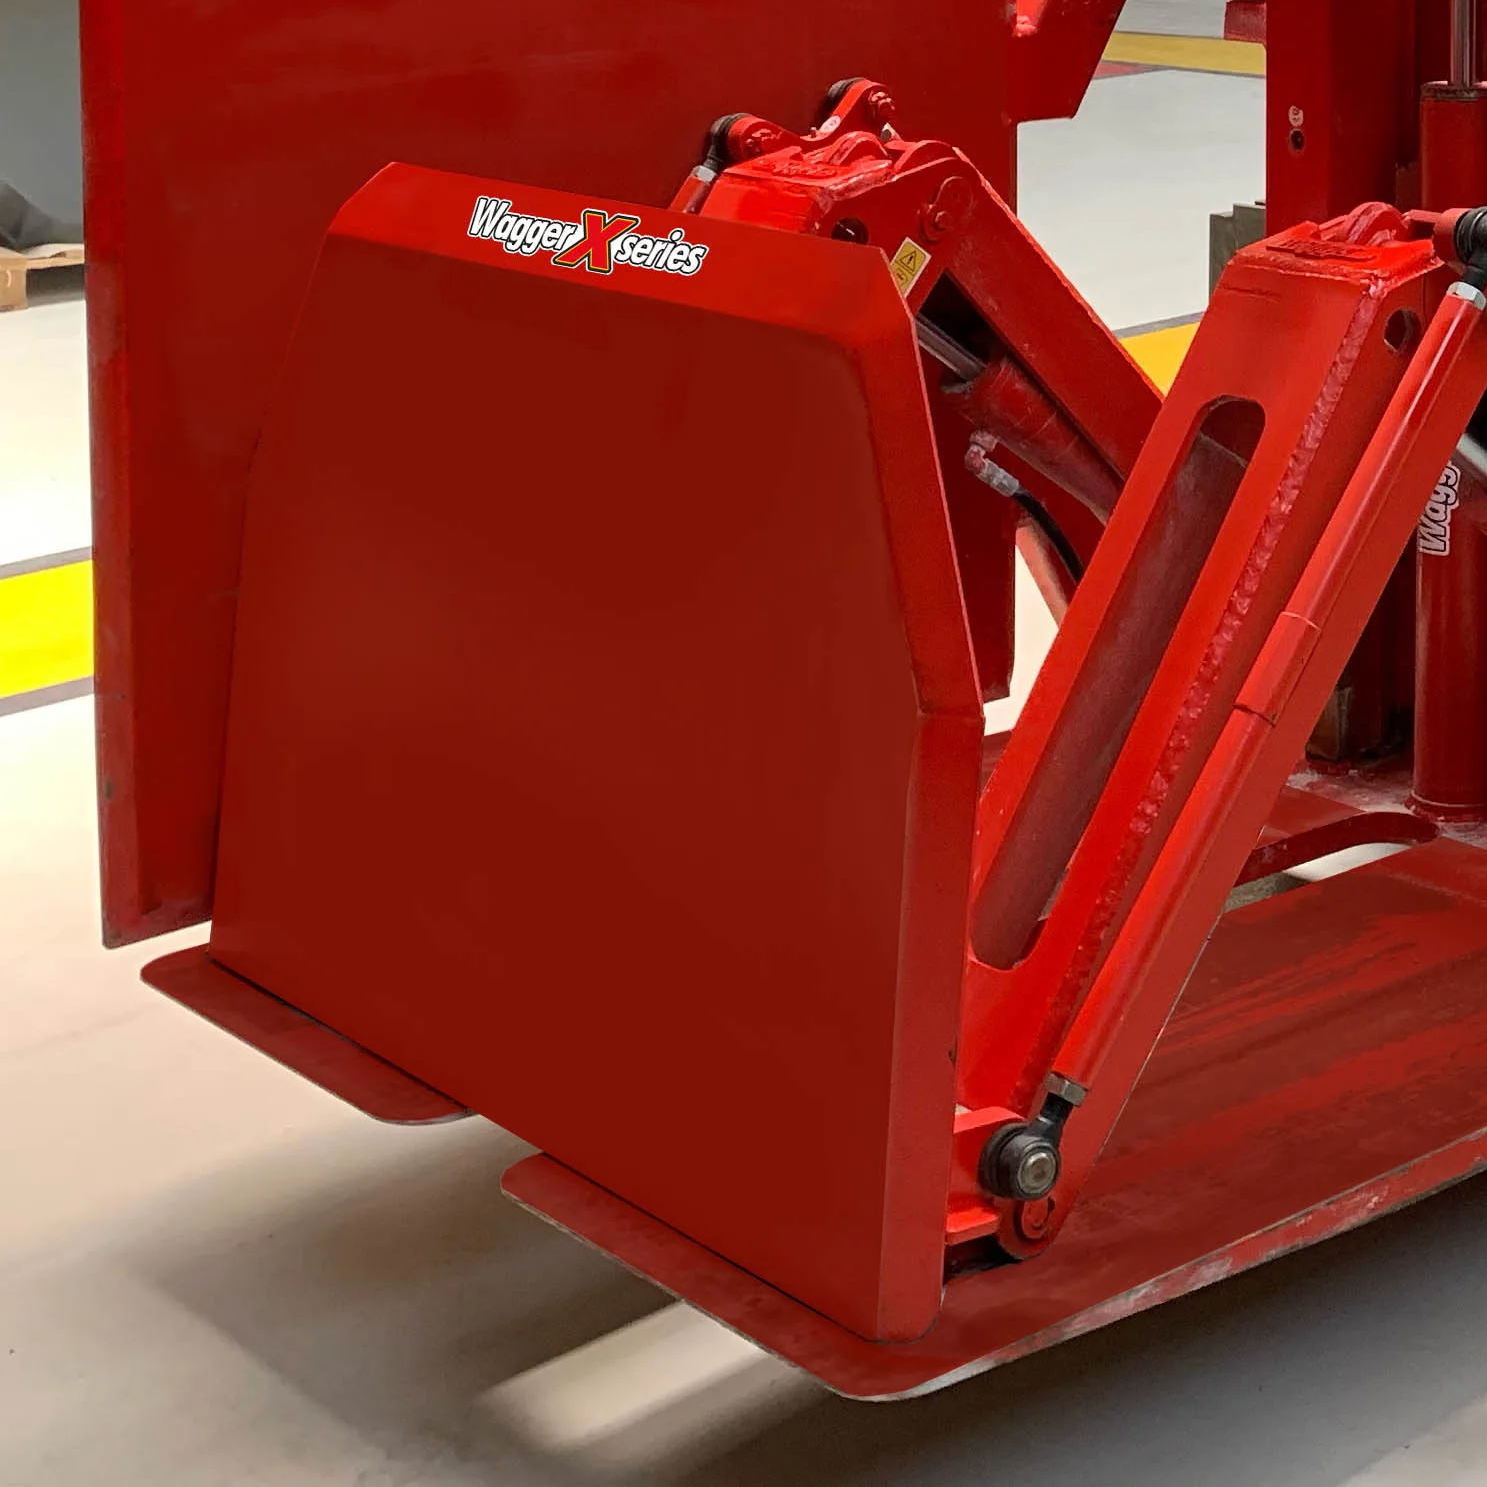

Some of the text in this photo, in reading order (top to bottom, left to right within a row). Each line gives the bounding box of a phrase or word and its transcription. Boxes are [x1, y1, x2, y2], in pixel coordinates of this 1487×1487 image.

[468, 196, 579, 255] Wagger
[613, 229, 708, 275] series
[1417, 460, 1460, 556] Wagg
